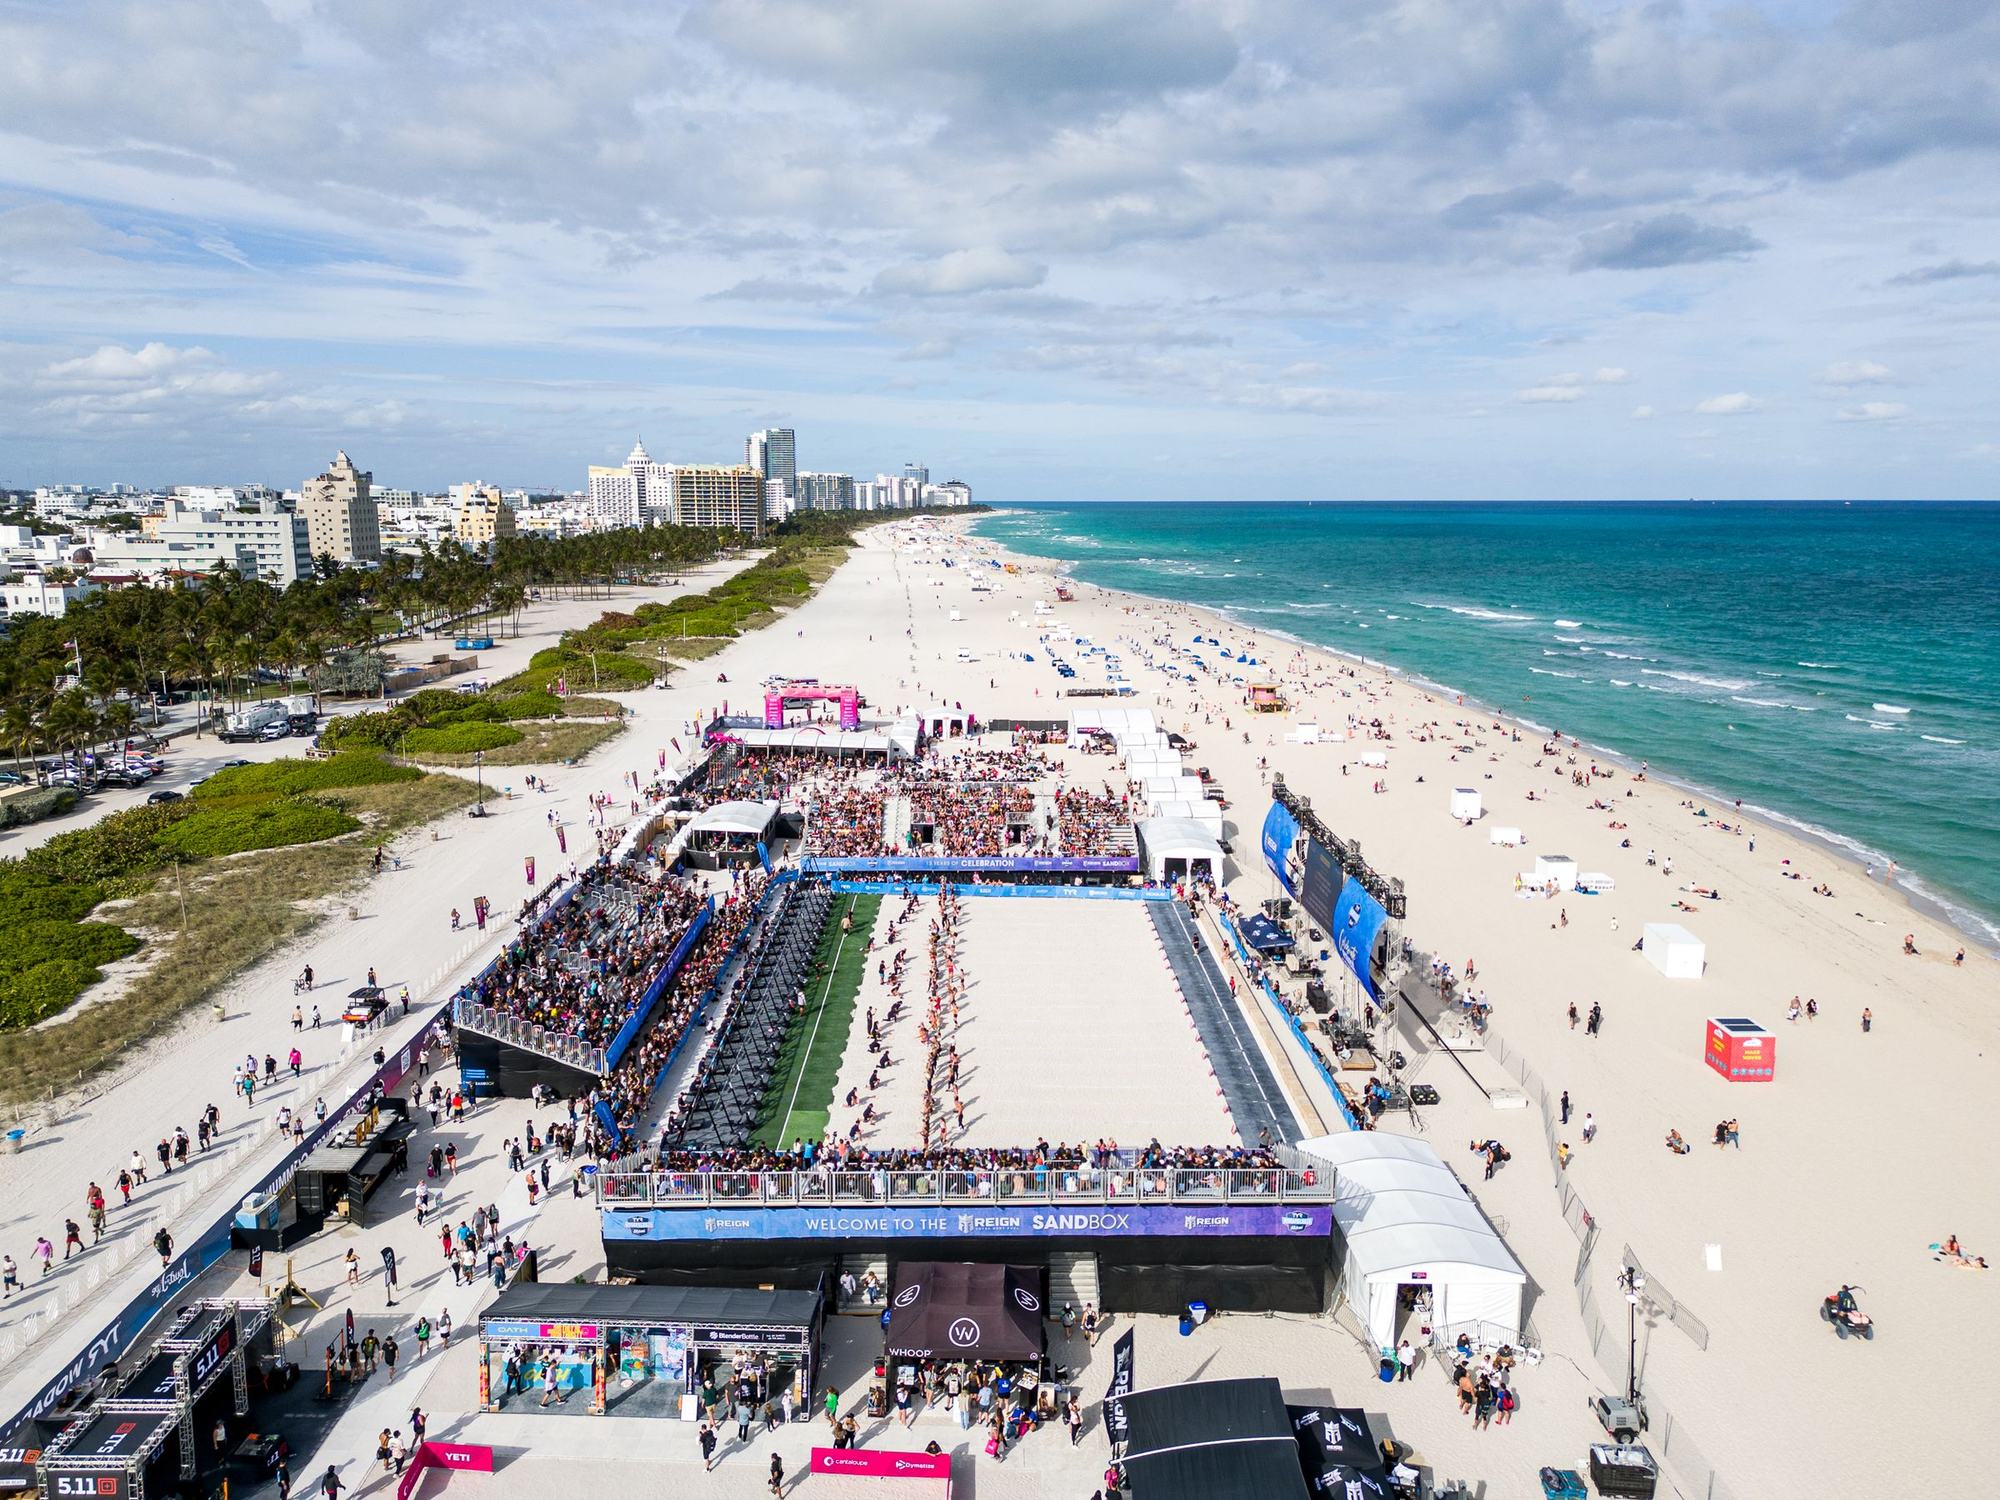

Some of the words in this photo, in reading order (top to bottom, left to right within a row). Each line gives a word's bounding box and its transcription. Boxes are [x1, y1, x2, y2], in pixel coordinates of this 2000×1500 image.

[961, 859, 1015, 867] CELEBRATION
[1064, 888, 1077, 896] TYR
[716, 1220, 750, 1228] REIGN
[806, 1218, 888, 1231] WELCOME
[894, 1218, 914, 1230] TO
[920, 1218, 947, 1230] THE
[974, 1217, 1020, 1227] REIGN
[1032, 1214, 1129, 1230] SANDBOX
[1196, 1217, 1229, 1225] REIGN
[718, 1332, 759, 1340] BlenderBottle
[889, 1348, 931, 1358] WHOOP
[197, 1343, 220, 1380] 5.11
[1114, 1370, 1129, 1430] REGN
[97, 1433, 128, 1453] 5.11
[445, 1452, 470, 1462] YETI
[58, 1477, 97, 1494] 5.11
